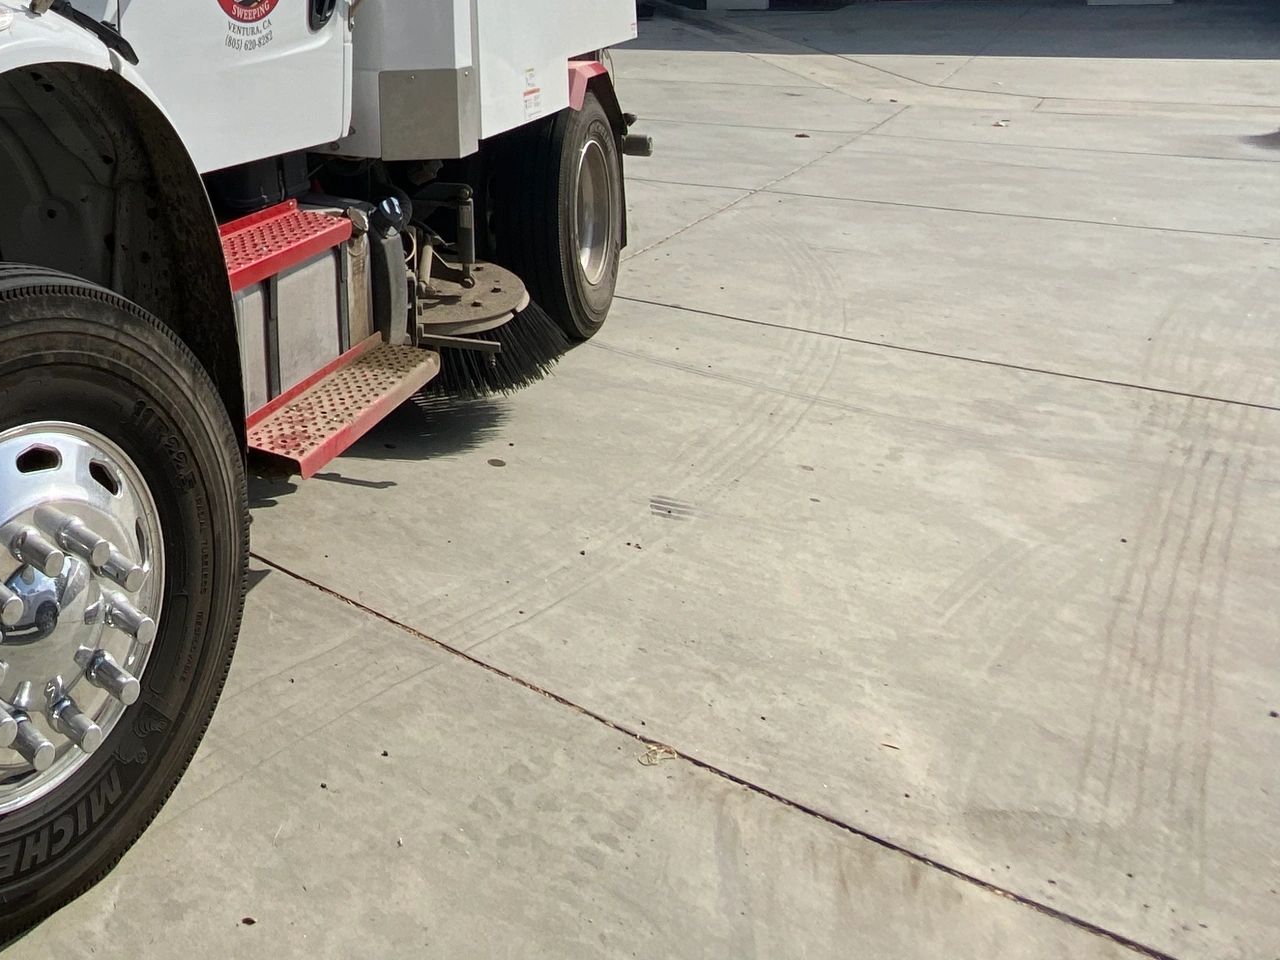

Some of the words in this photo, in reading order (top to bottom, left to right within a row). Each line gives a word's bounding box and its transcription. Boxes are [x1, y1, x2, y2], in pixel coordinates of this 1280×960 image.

[231, 0, 271, 20] SWEEPING
[262, 18, 272, 30] CA
[225, 34, 243, 51] (805)
